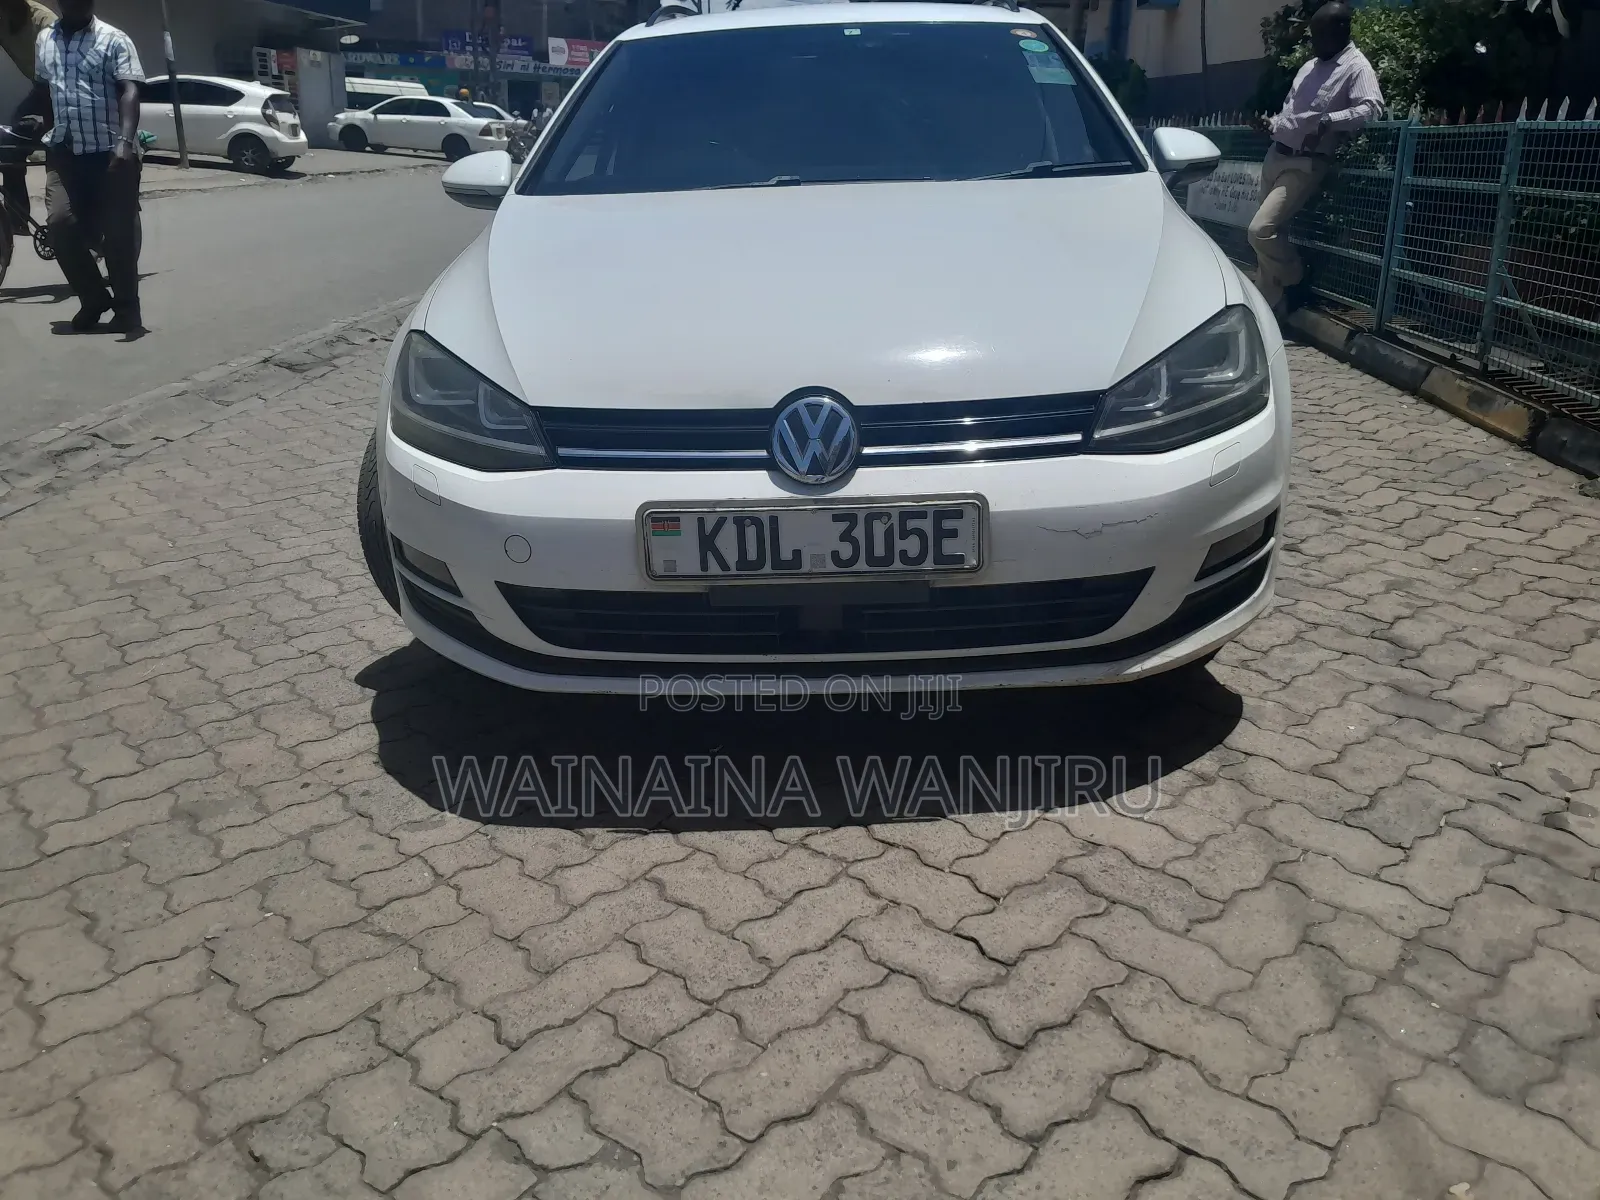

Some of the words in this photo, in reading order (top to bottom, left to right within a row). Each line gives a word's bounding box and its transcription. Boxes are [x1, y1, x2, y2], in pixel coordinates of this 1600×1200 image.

[533, 64, 581, 75] Hermosa
[697, 516, 802, 572] KDL
[830, 508, 966, 568] 305E
